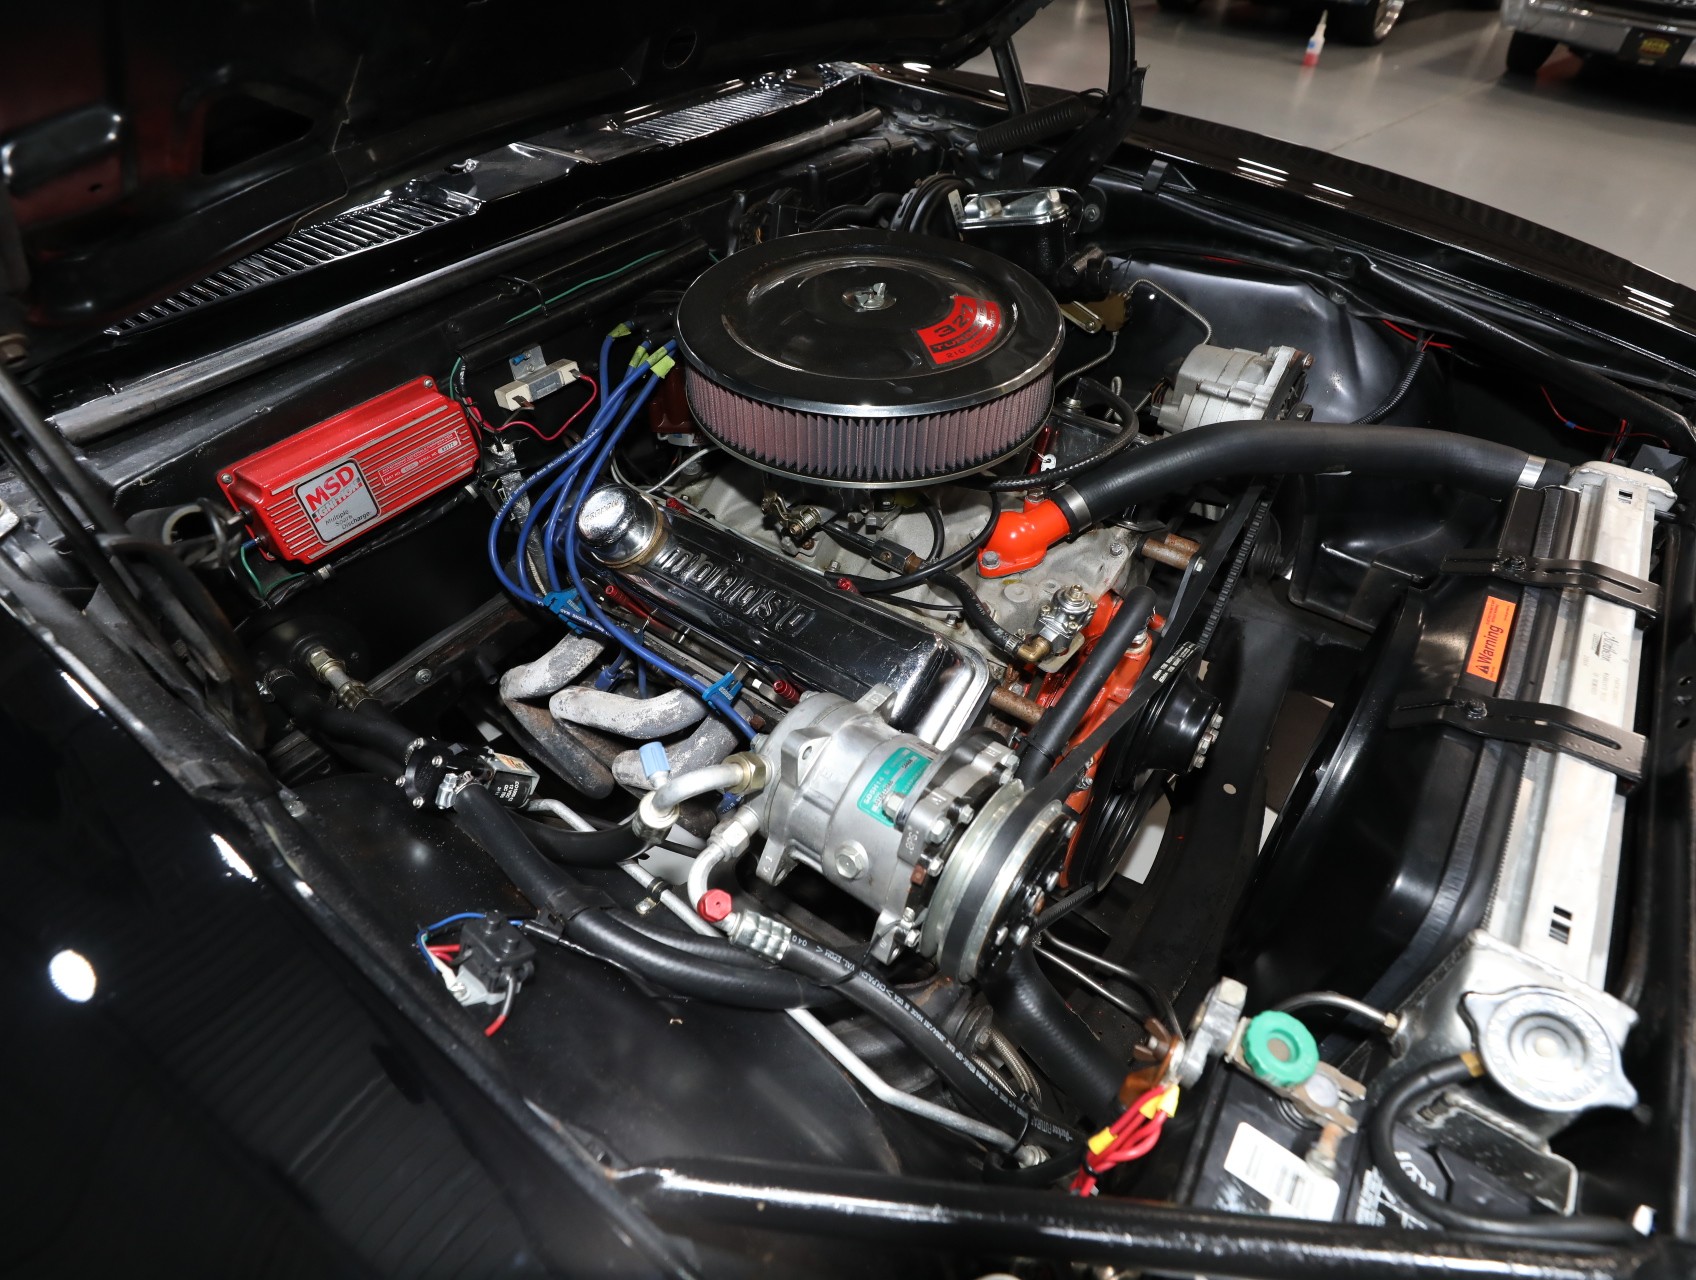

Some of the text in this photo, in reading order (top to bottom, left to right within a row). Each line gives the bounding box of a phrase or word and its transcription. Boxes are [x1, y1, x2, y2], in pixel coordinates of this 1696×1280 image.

[934, 303, 974, 338] 327
[304, 466, 354, 512] MSD
[325, 509, 349, 526] Multiple
[341, 511, 372, 530] Discharge
[1476, 623, 1504, 664] Warning
[790, 933, 808, 947] 040
